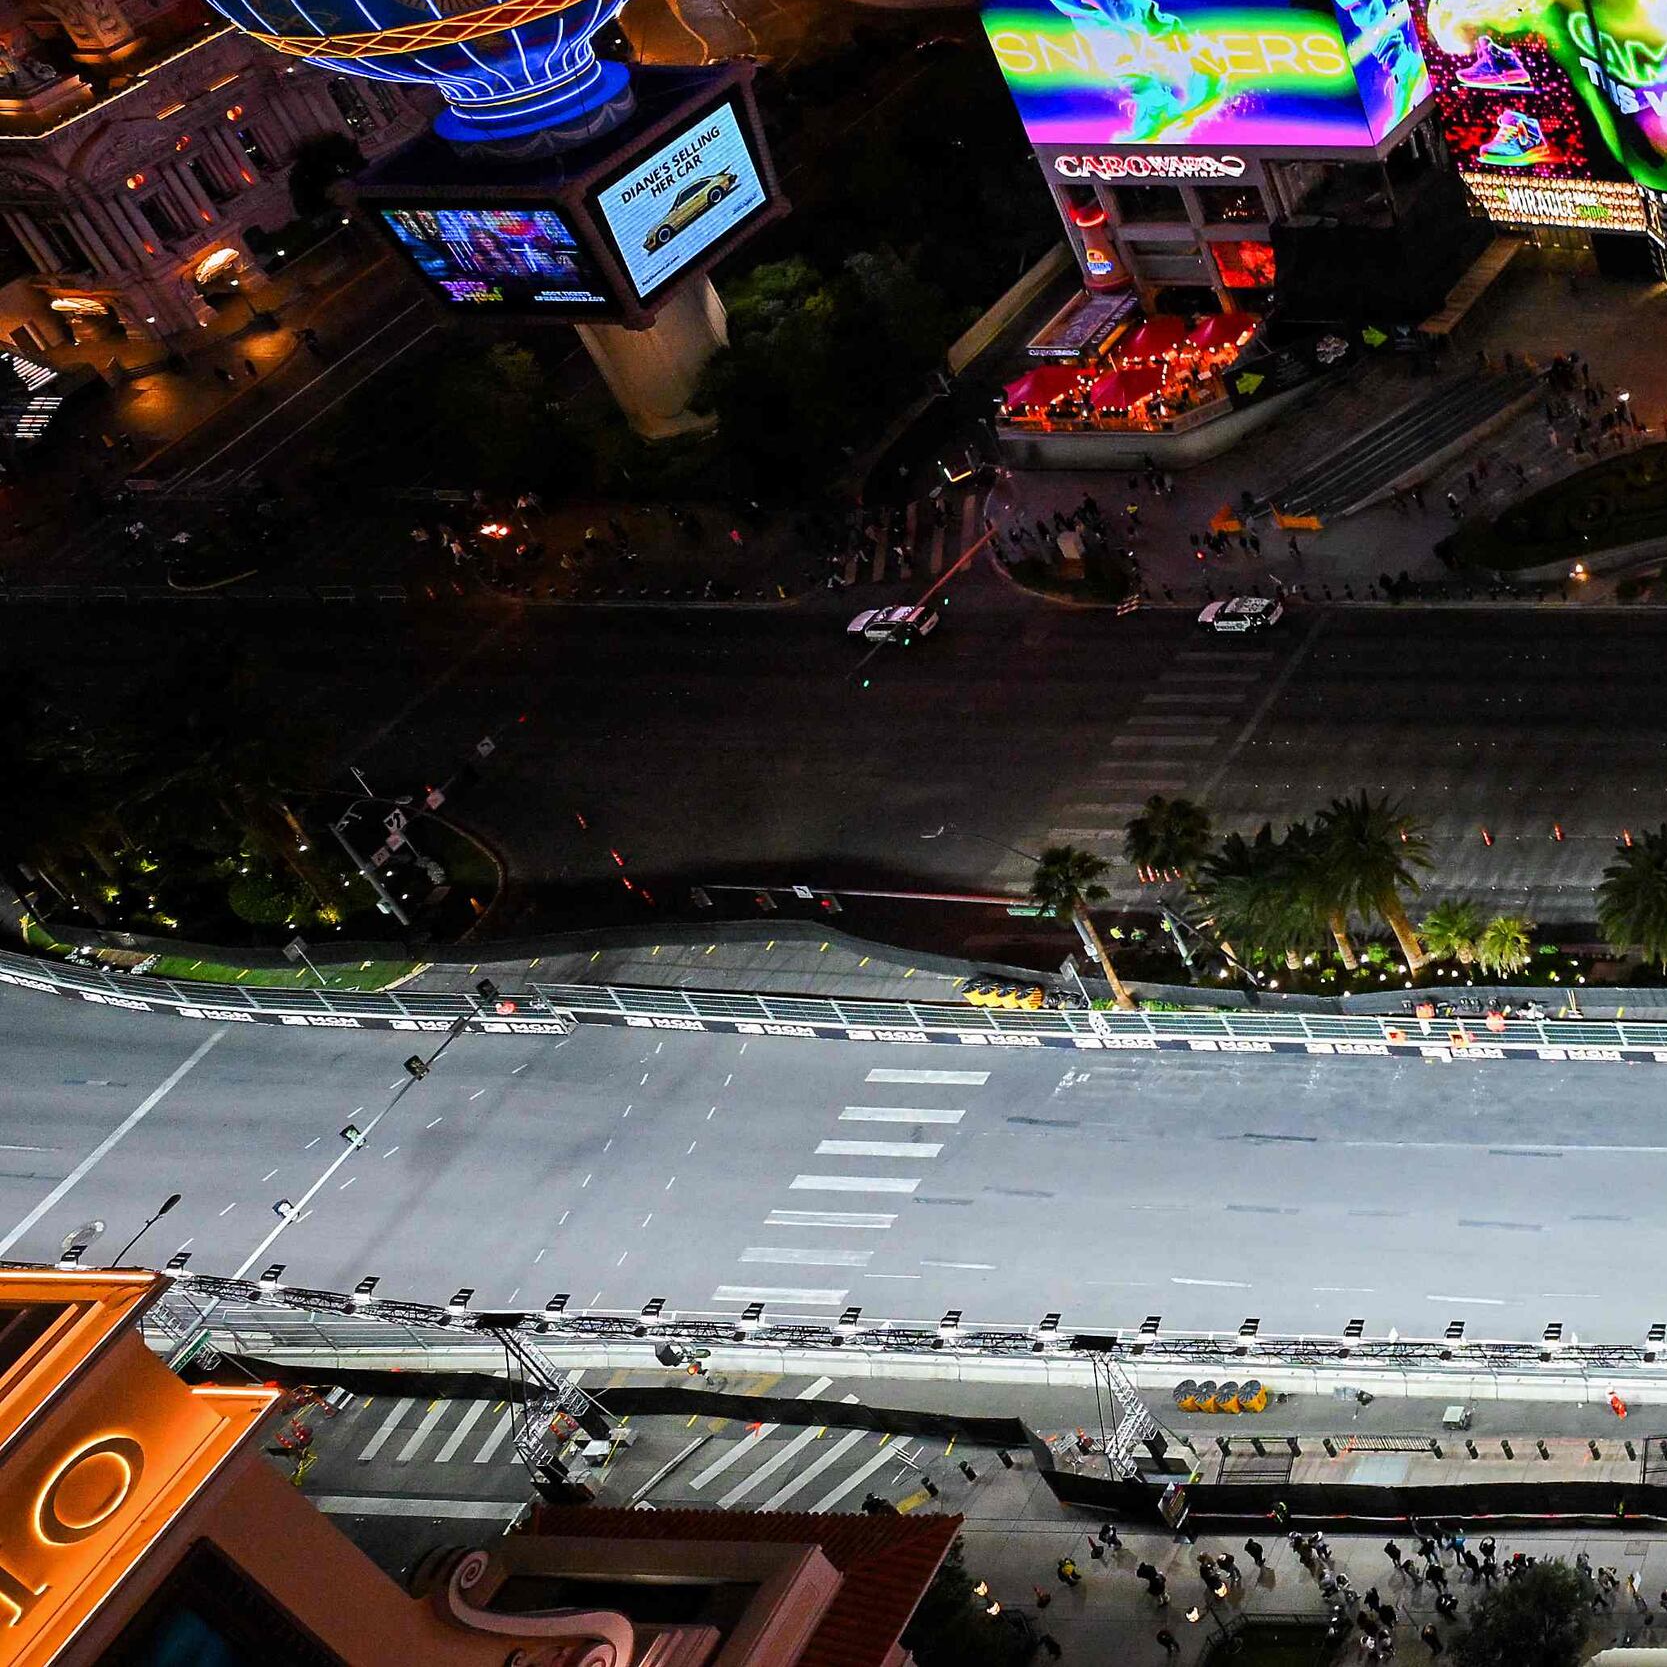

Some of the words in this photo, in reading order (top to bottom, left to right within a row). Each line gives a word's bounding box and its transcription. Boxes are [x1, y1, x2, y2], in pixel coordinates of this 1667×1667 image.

[620, 160, 671, 204] DIANE'S
[671, 125, 721, 168] SELLING
[650, 175, 676, 199] HER
[676, 153, 704, 179] CAR
[1054, 155, 1152, 181] CABO
[1504, 186, 1576, 218] MIRACLE
